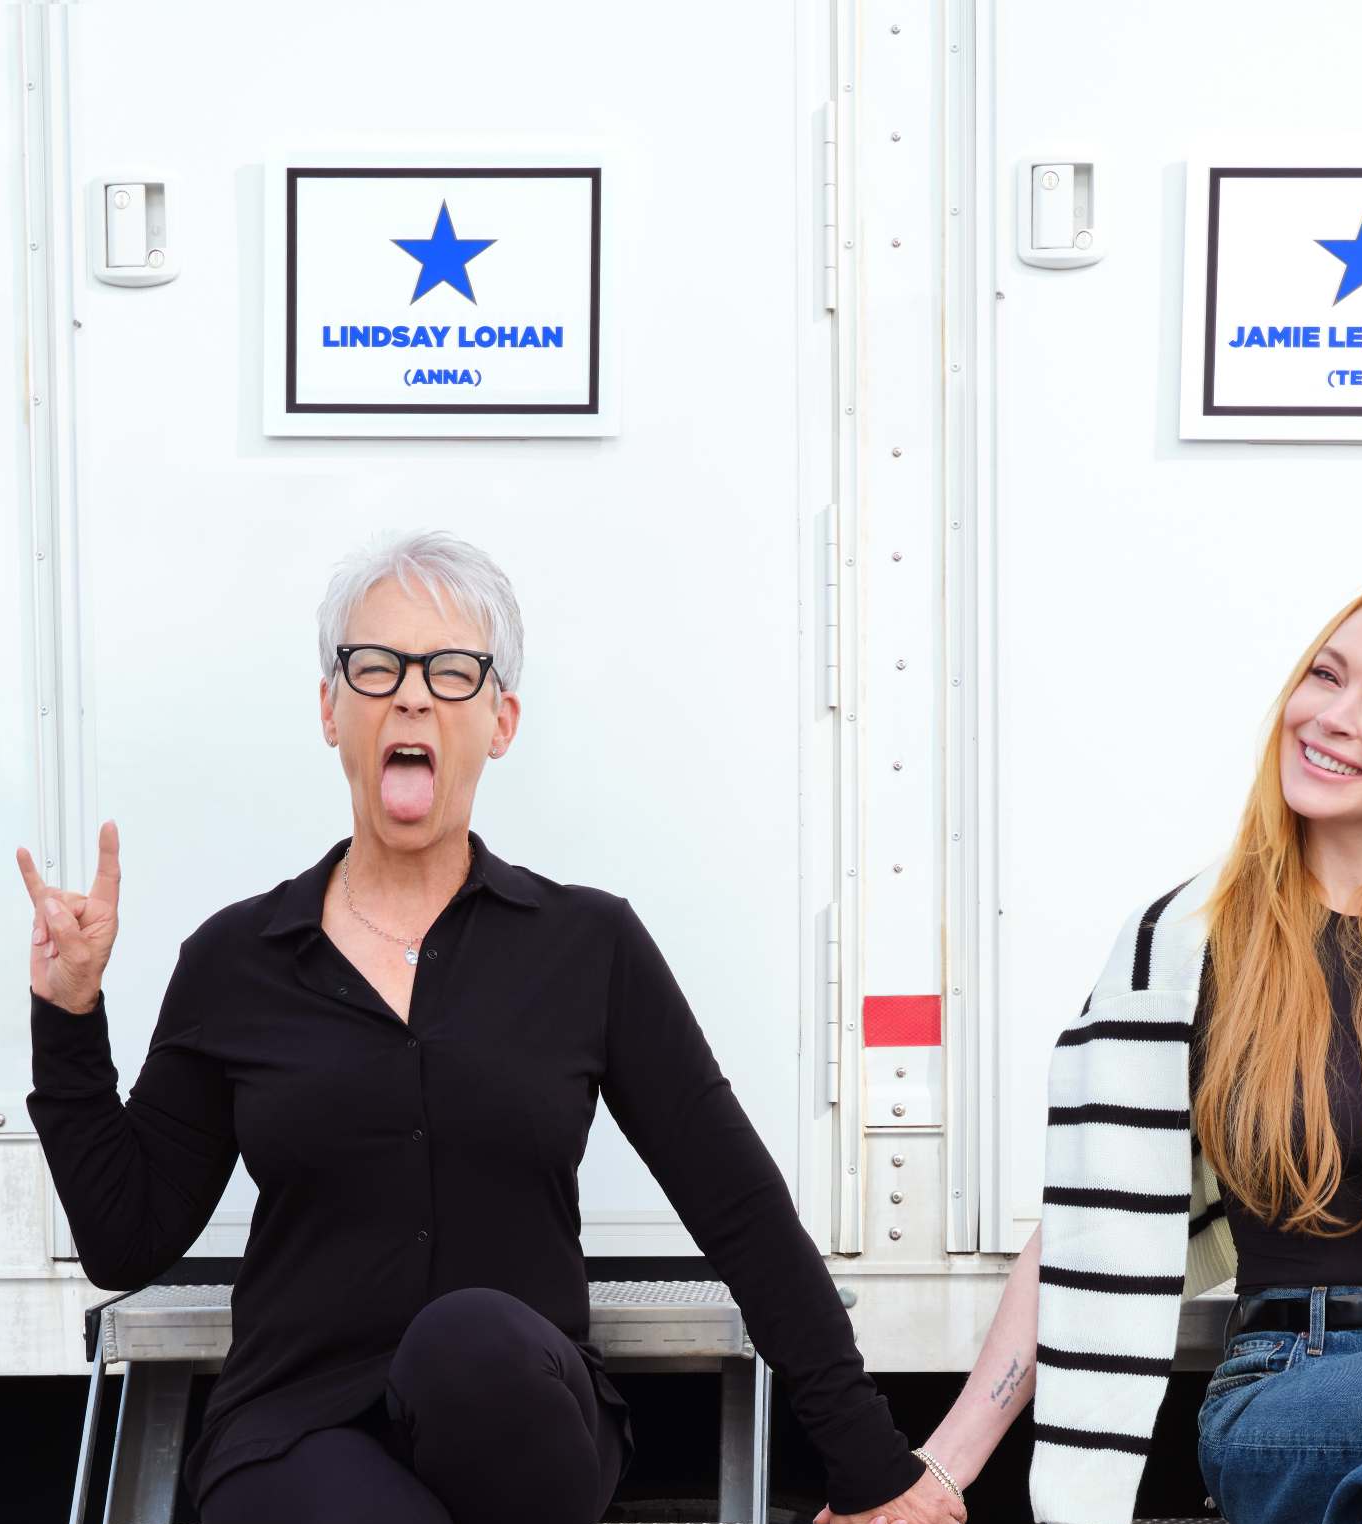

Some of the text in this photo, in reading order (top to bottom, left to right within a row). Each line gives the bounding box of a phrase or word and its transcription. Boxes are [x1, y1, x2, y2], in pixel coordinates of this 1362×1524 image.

[322, 325, 564, 349] LINDSAY LOHAN
[1228, 325, 1321, 349] JAMIE
[404, 368, 482, 385] (ANNA)
